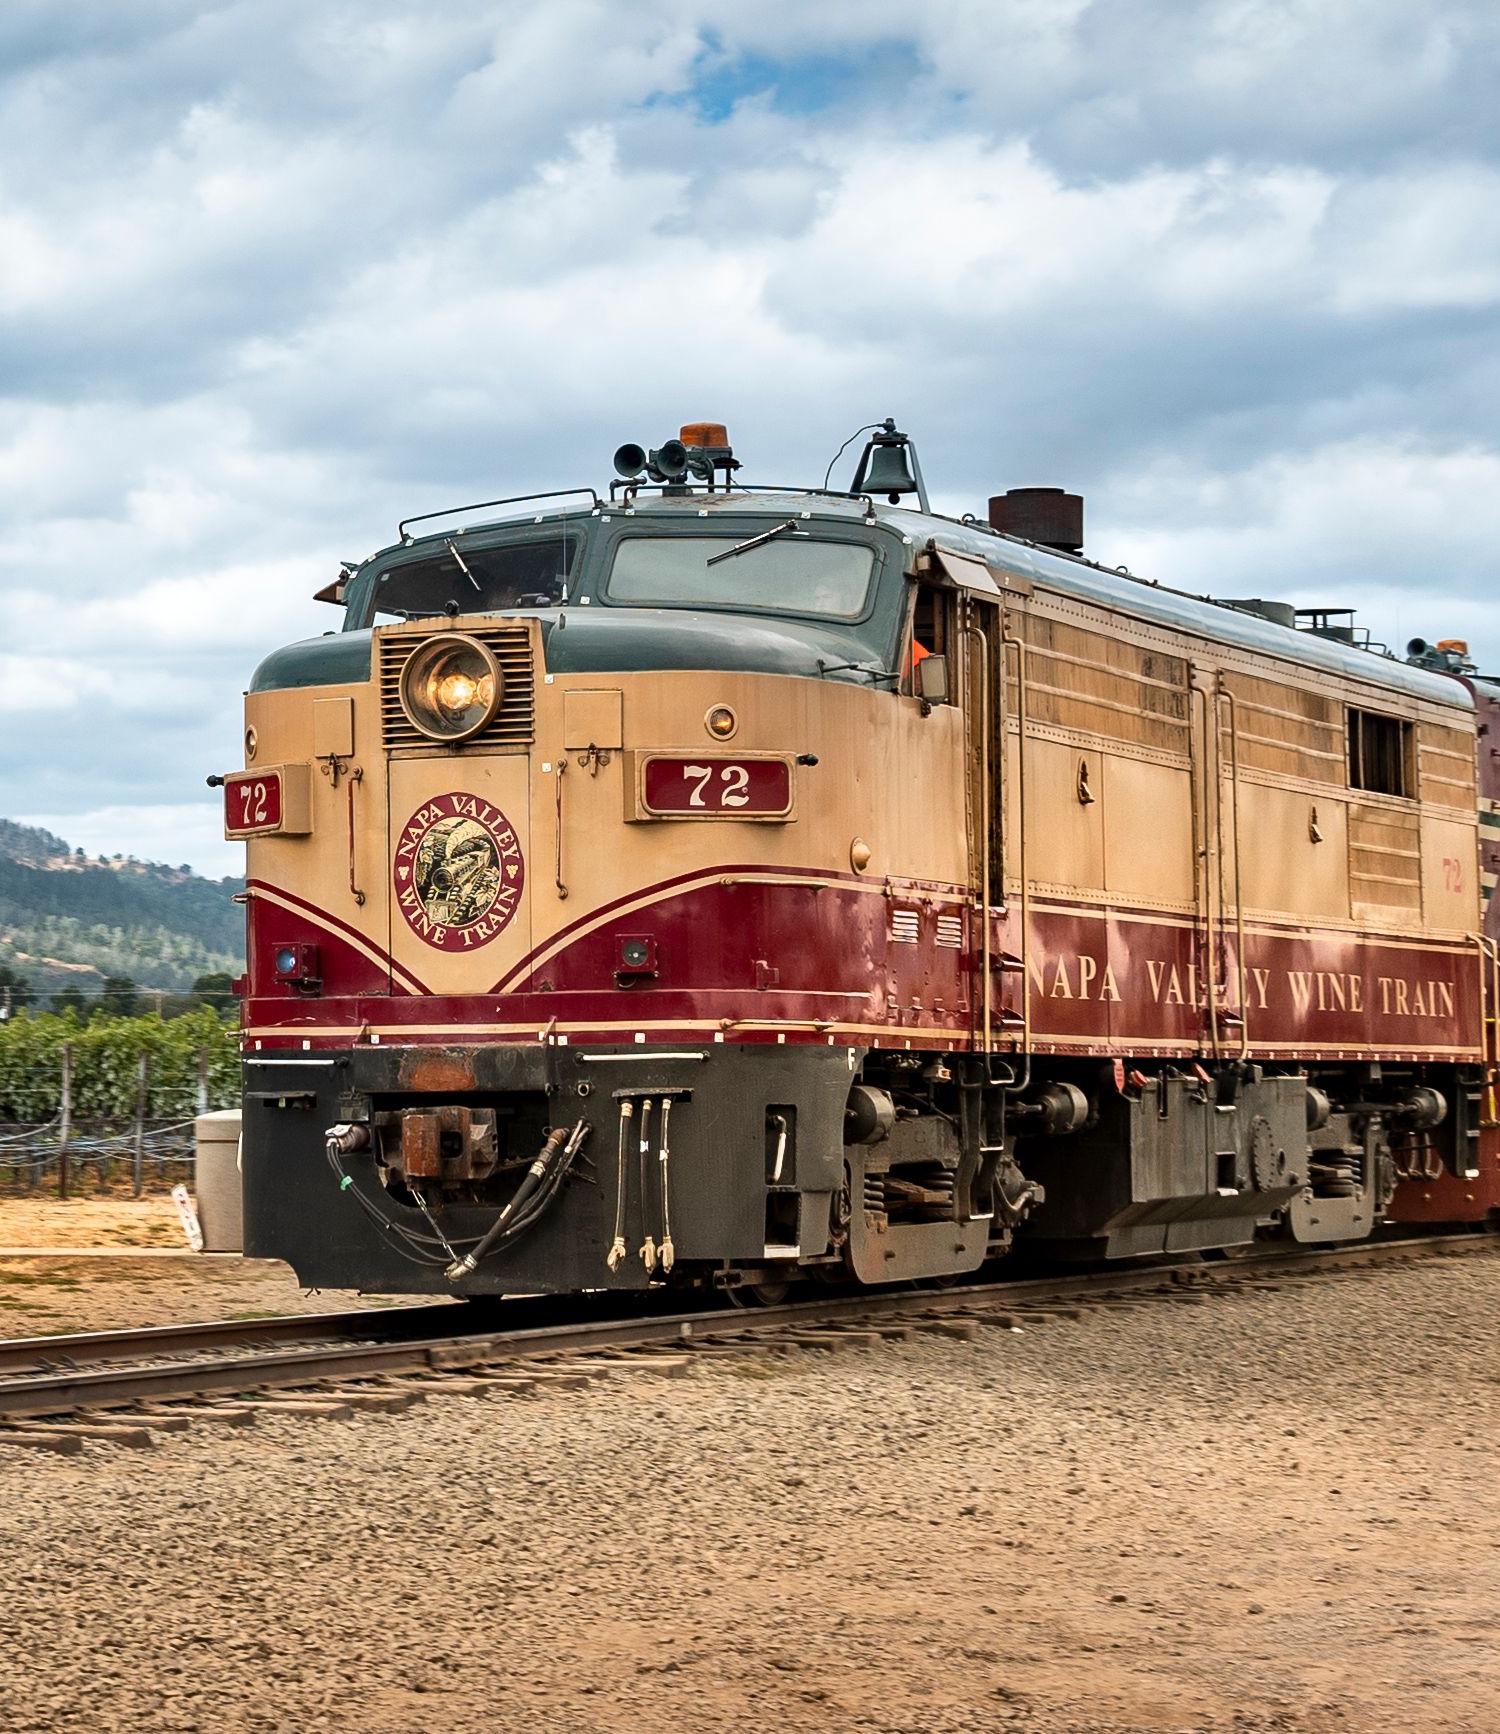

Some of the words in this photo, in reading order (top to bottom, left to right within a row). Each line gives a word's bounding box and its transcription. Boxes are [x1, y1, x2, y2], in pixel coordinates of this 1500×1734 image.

[240, 782, 267, 824] 72
[683, 765, 750, 807] 72
[398, 803, 446, 860] NAPA
[450, 795, 521, 859] VALLEY
[1442, 858, 1463, 893] 72
[400, 885, 447, 945] WINE
[457, 883, 518, 946] TRAIN
[1027, 951, 1122, 1002] NAPA
[1287, 970, 1364, 1013] WINE
[1378, 976, 1455, 1018] TRAIN
[847, 1047, 856, 1071] F
